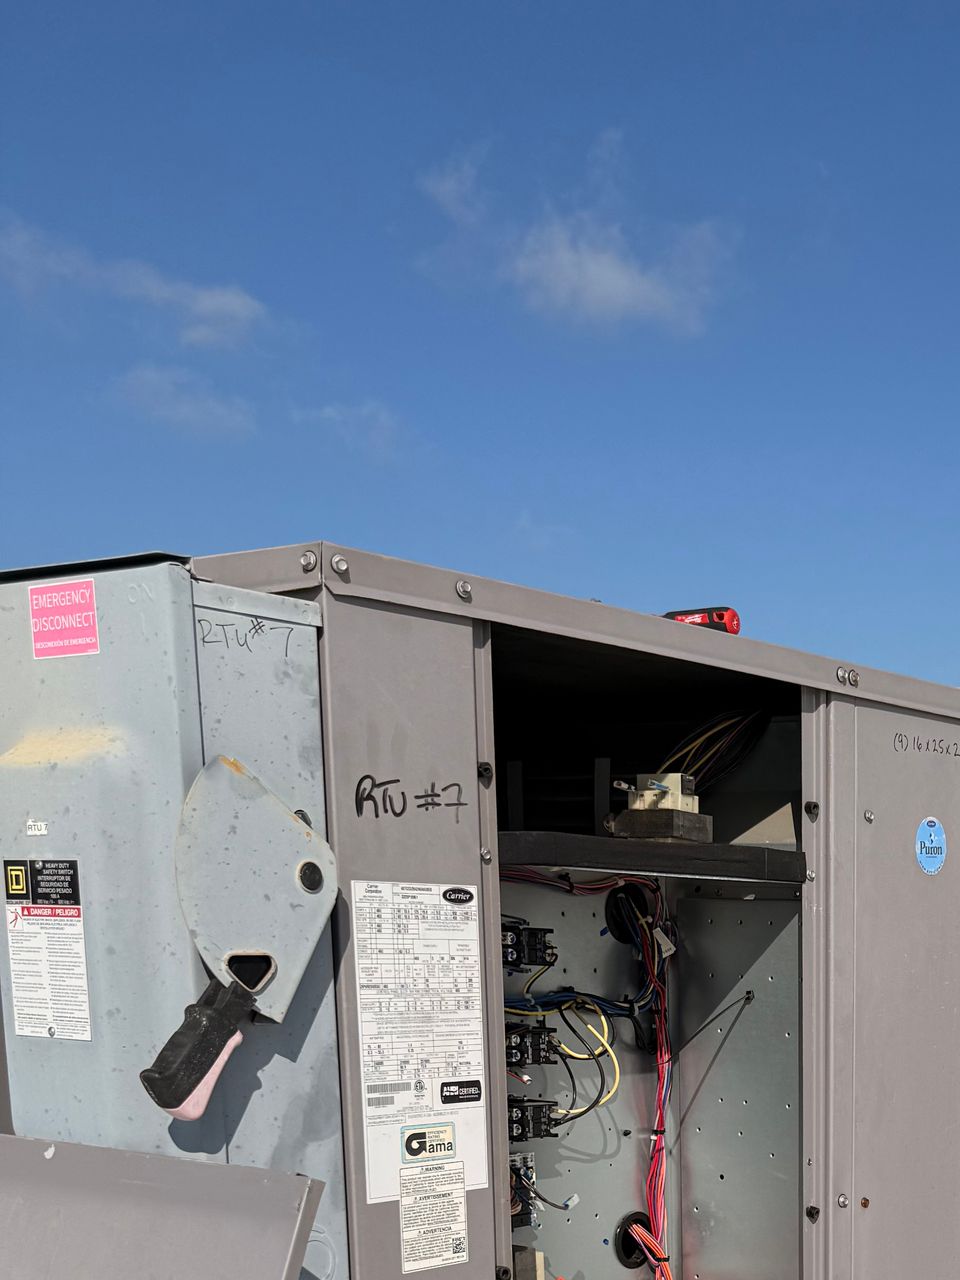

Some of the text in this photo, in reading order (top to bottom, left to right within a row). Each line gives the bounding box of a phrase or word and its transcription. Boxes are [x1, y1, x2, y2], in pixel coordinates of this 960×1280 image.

[33, 588, 90, 609] EMERGENCY
[32, 612, 94, 632] DISCONNECT
[355, 774, 408, 818] RTU
[28, 824, 42, 832] RTU
[920, 840, 942, 855] Puron
[446, 891, 470, 900] Carrier
[419, 1192, 453, 1200] AVERTISSEMENT
[423, 1226, 452, 1235] ADVERTENCIA
